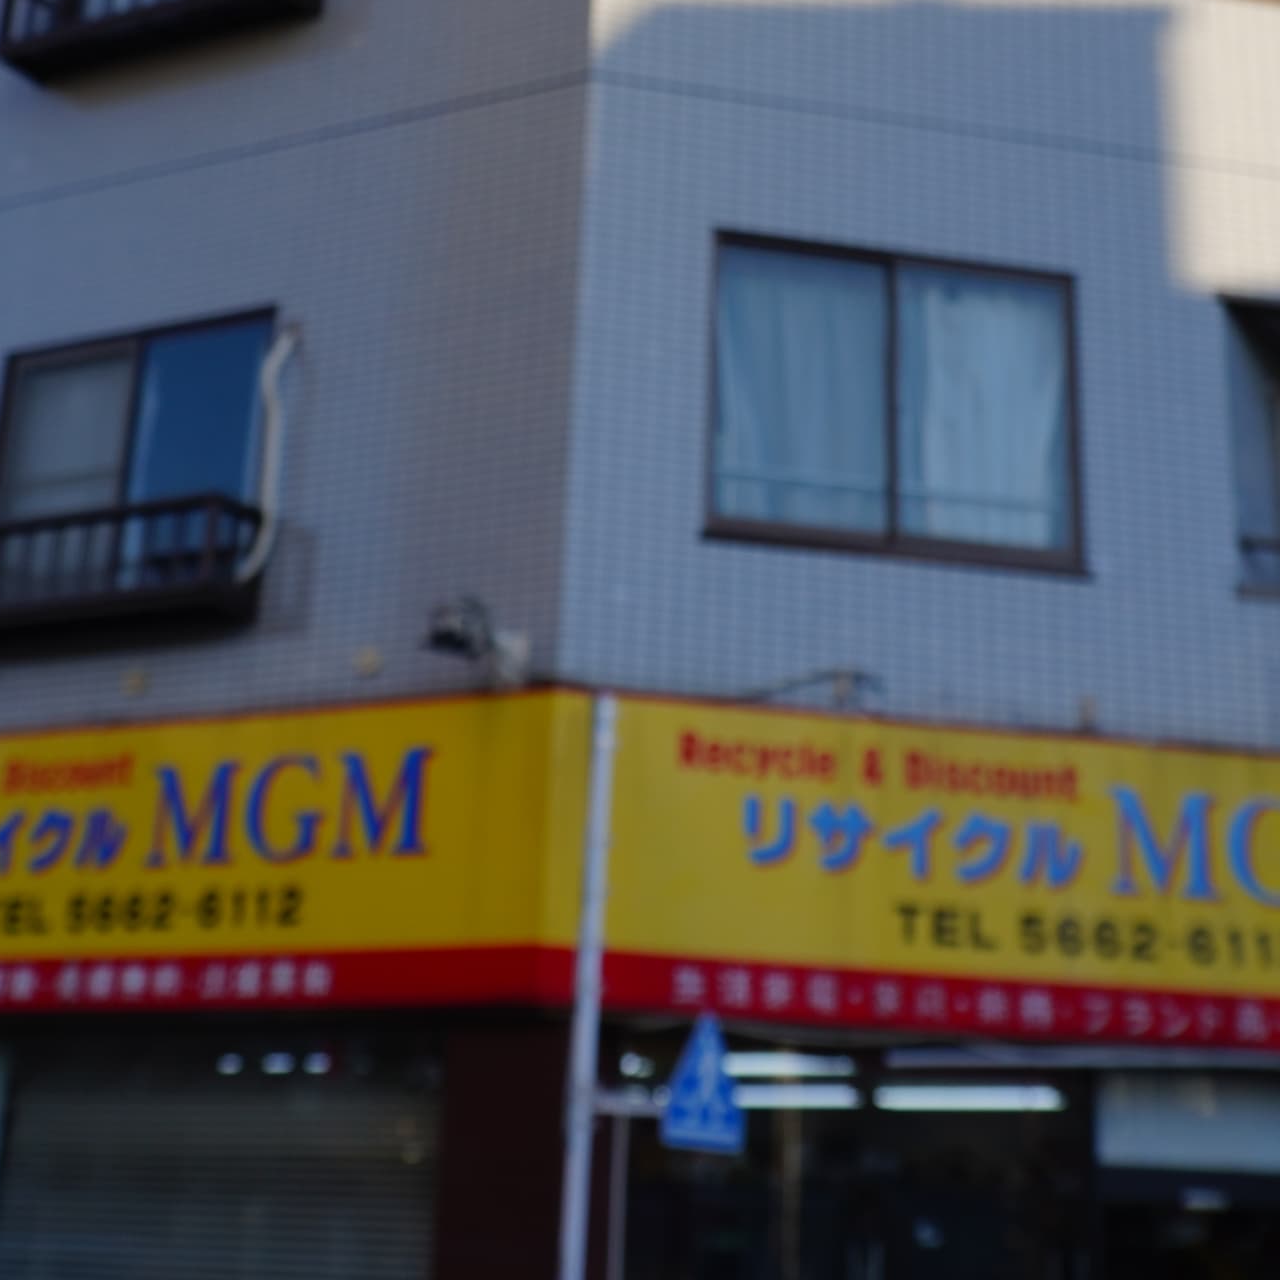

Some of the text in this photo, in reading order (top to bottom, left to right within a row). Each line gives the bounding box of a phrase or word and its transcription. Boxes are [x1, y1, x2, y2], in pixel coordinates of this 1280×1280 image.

[144, 746, 436, 870] MGM
[678, 729, 1080, 804] Recycle & Discount
[741, 796, 1084, 888] リサイクル
[894, 904, 999, 952] TEL
